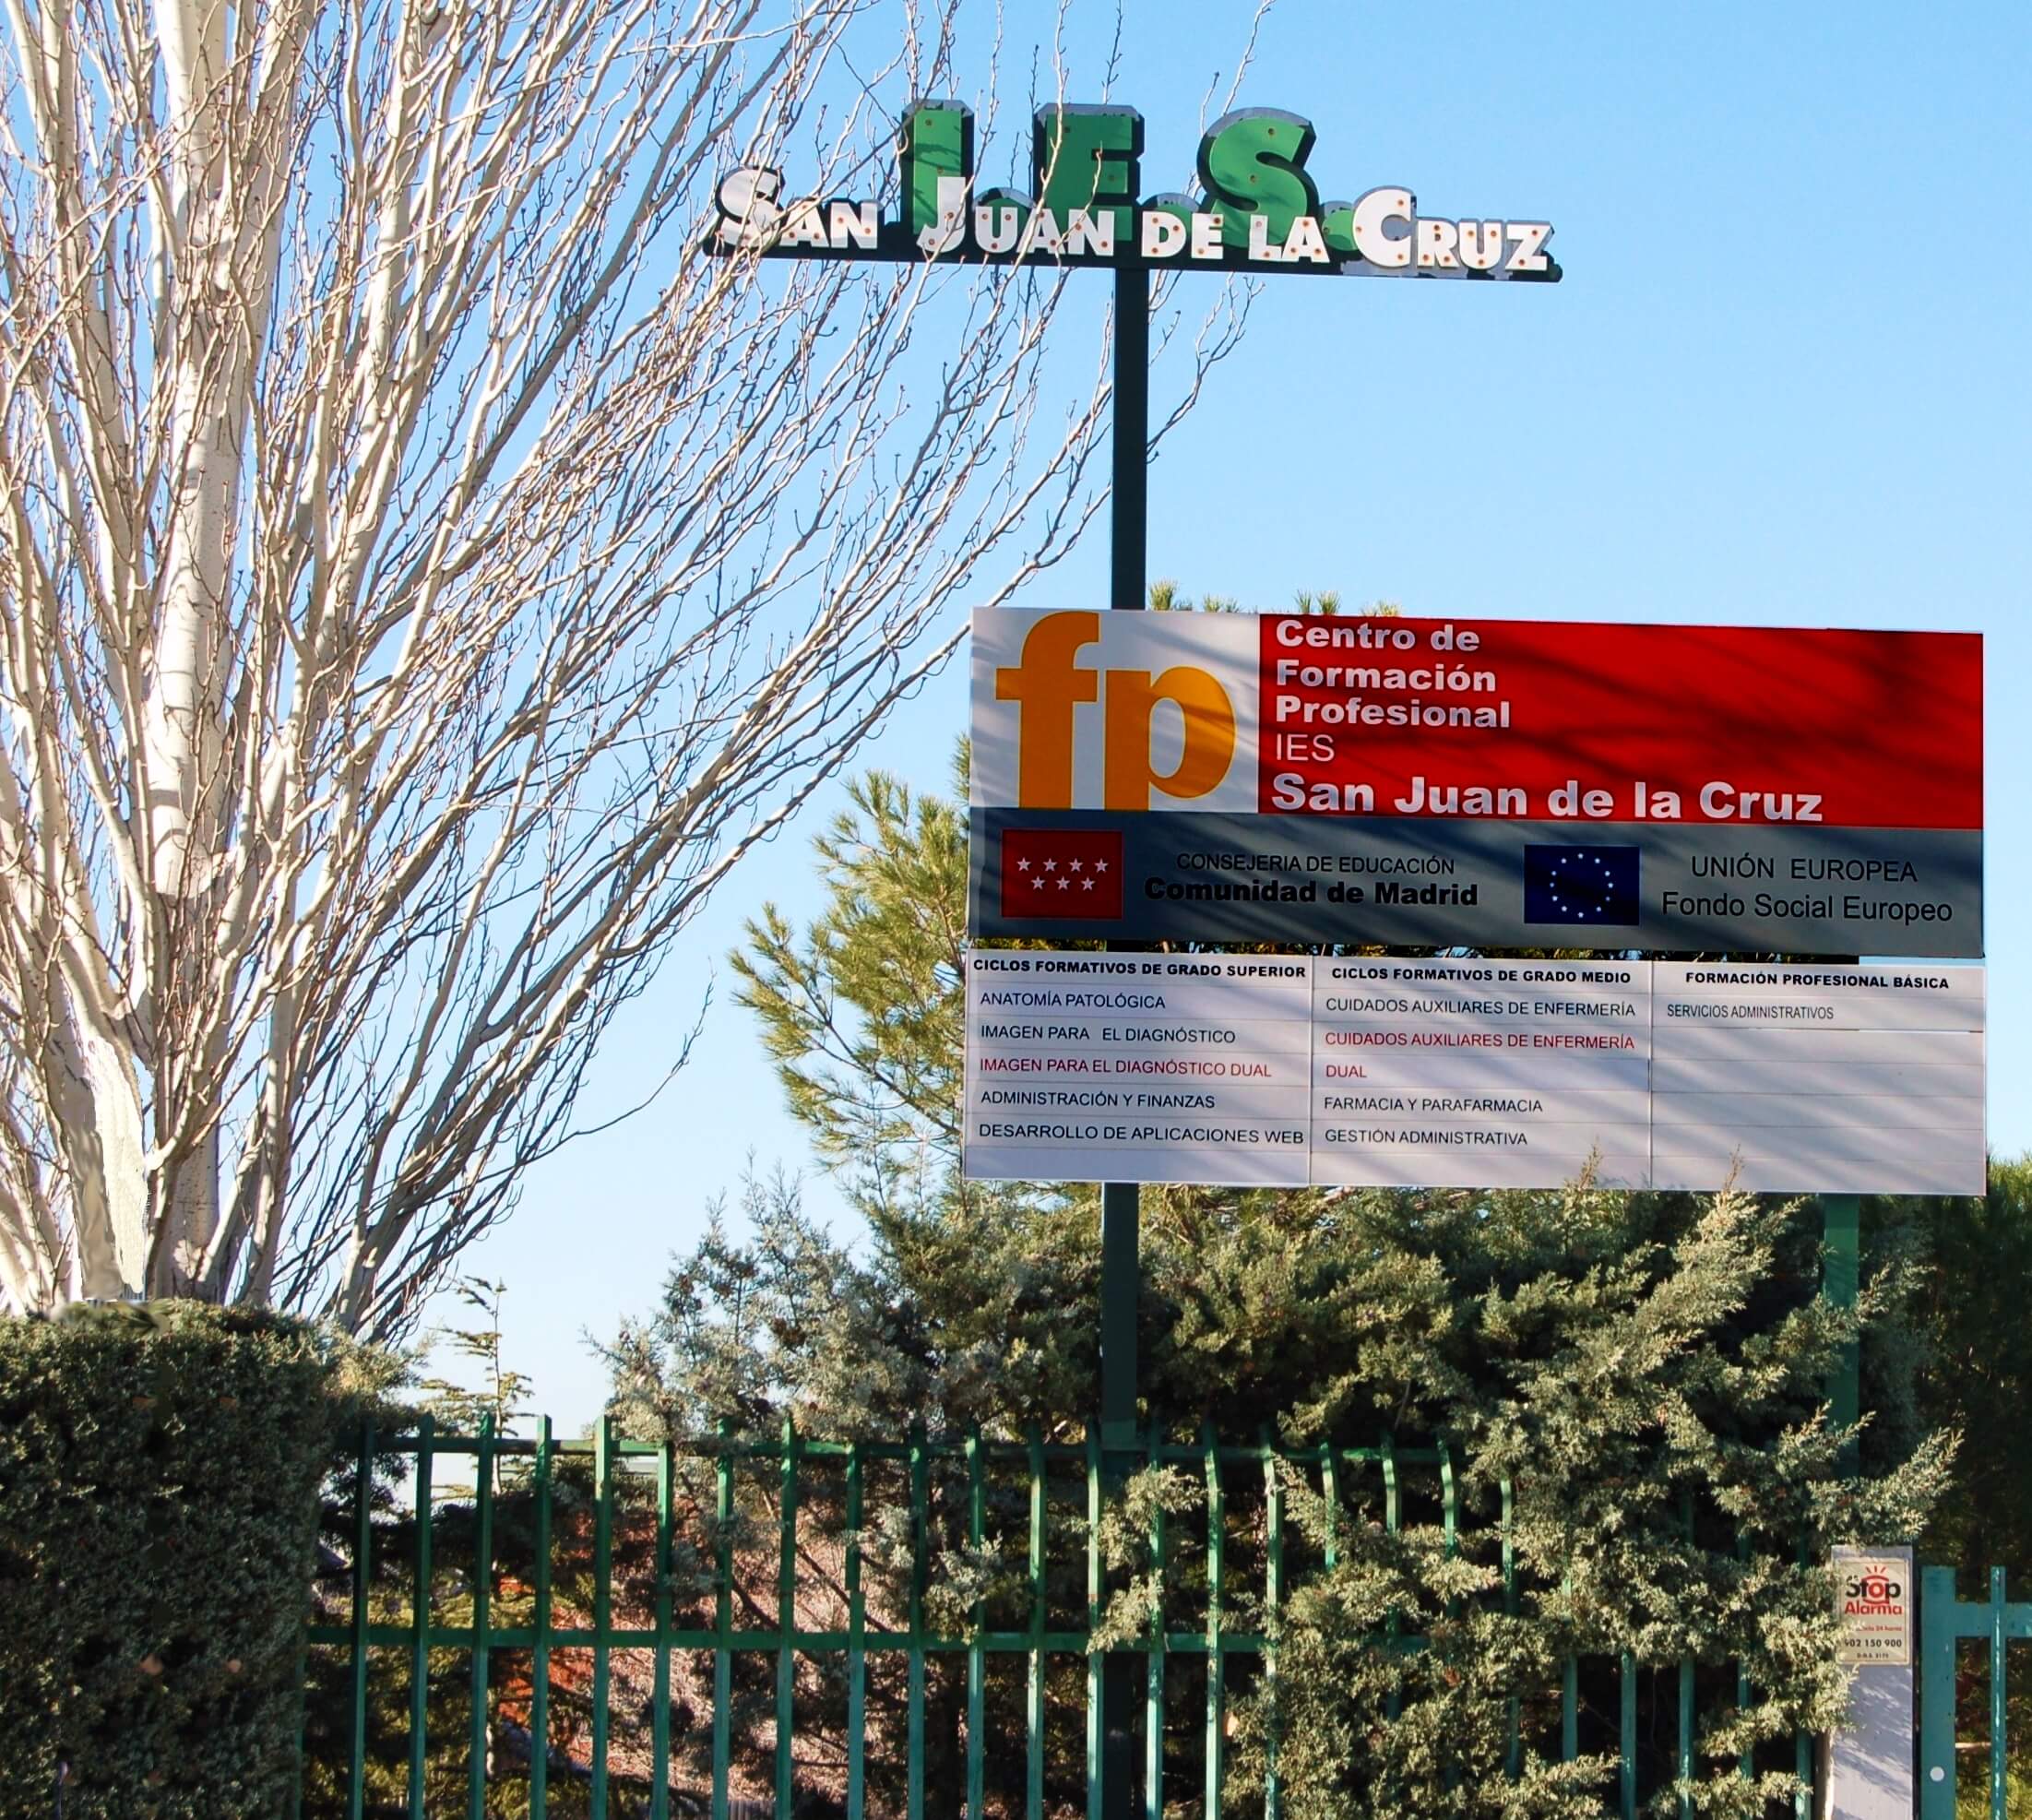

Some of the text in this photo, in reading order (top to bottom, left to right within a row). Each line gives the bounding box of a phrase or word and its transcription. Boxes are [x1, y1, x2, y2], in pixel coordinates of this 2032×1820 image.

[718, 168, 1552, 271] SAN JUAN DE LA CRUZ
[1276, 619, 1480, 651] Centro de
[1277, 659, 1496, 692] Formación
[995, 611, 1238, 812] fp
[1276, 695, 1510, 728] Profesional
[1276, 733, 1336, 762] IES
[1271, 772, 1823, 822] San Juan de la Cruz
[1176, 852, 1455, 875] CONSEJERIA DE EDUCACIÓN
[1691, 851, 1919, 883] UNIÓN EUROPEA
[1144, 876, 1479, 906] Comunidad de Madrid
[1662, 891, 1953, 926] Fondo Social Europeo
[973, 958, 1306, 978] CICLOS FORMATIVOS DE GRADO SUPERIOR
[1331, 968, 1631, 984] CICLOS FORMATIVOS DE GRADO MEDIO
[1685, 970, 1949, 989] FORMACIÓN PROFESIONAL BÁSICA
[980, 990, 1166, 1009] ANATOMÍA PATOLÓGICA
[1325, 997, 1636, 1017] CUIDADOS AUXILIARES DE ENFERMERÍA
[1667, 1003, 1835, 1020] SERVICIOS ADMINISTRATIVOS
[980, 1025, 1236, 1044] IMAGEN PARA EL DIAGNÓSTICO
[1325, 1032, 1635, 1049] CUIDADOS AUXILIARES DE ENFERMERÍA
[980, 1058, 1272, 1077] IMAGEN PARA EL DIAGNÓSTICO DUAL
[1325, 1065, 1367, 1078] DUAL
[980, 1090, 1216, 1109] ADMINISTRACIÓN Y FINANZAS
[1324, 1096, 1543, 1112] FARMACIA Y PARAFARMACIA
[979, 1124, 1304, 1145] DESARROLLO DE APLICACIONES WEB
[1325, 1128, 1528, 1145] GESTIÓN ADMINISTRATIVA
[1845, 1600, 1903, 1615] Alarma
[1865, 1638, 1882, 1648] 150
[1883, 1638, 1903, 1648] 900
